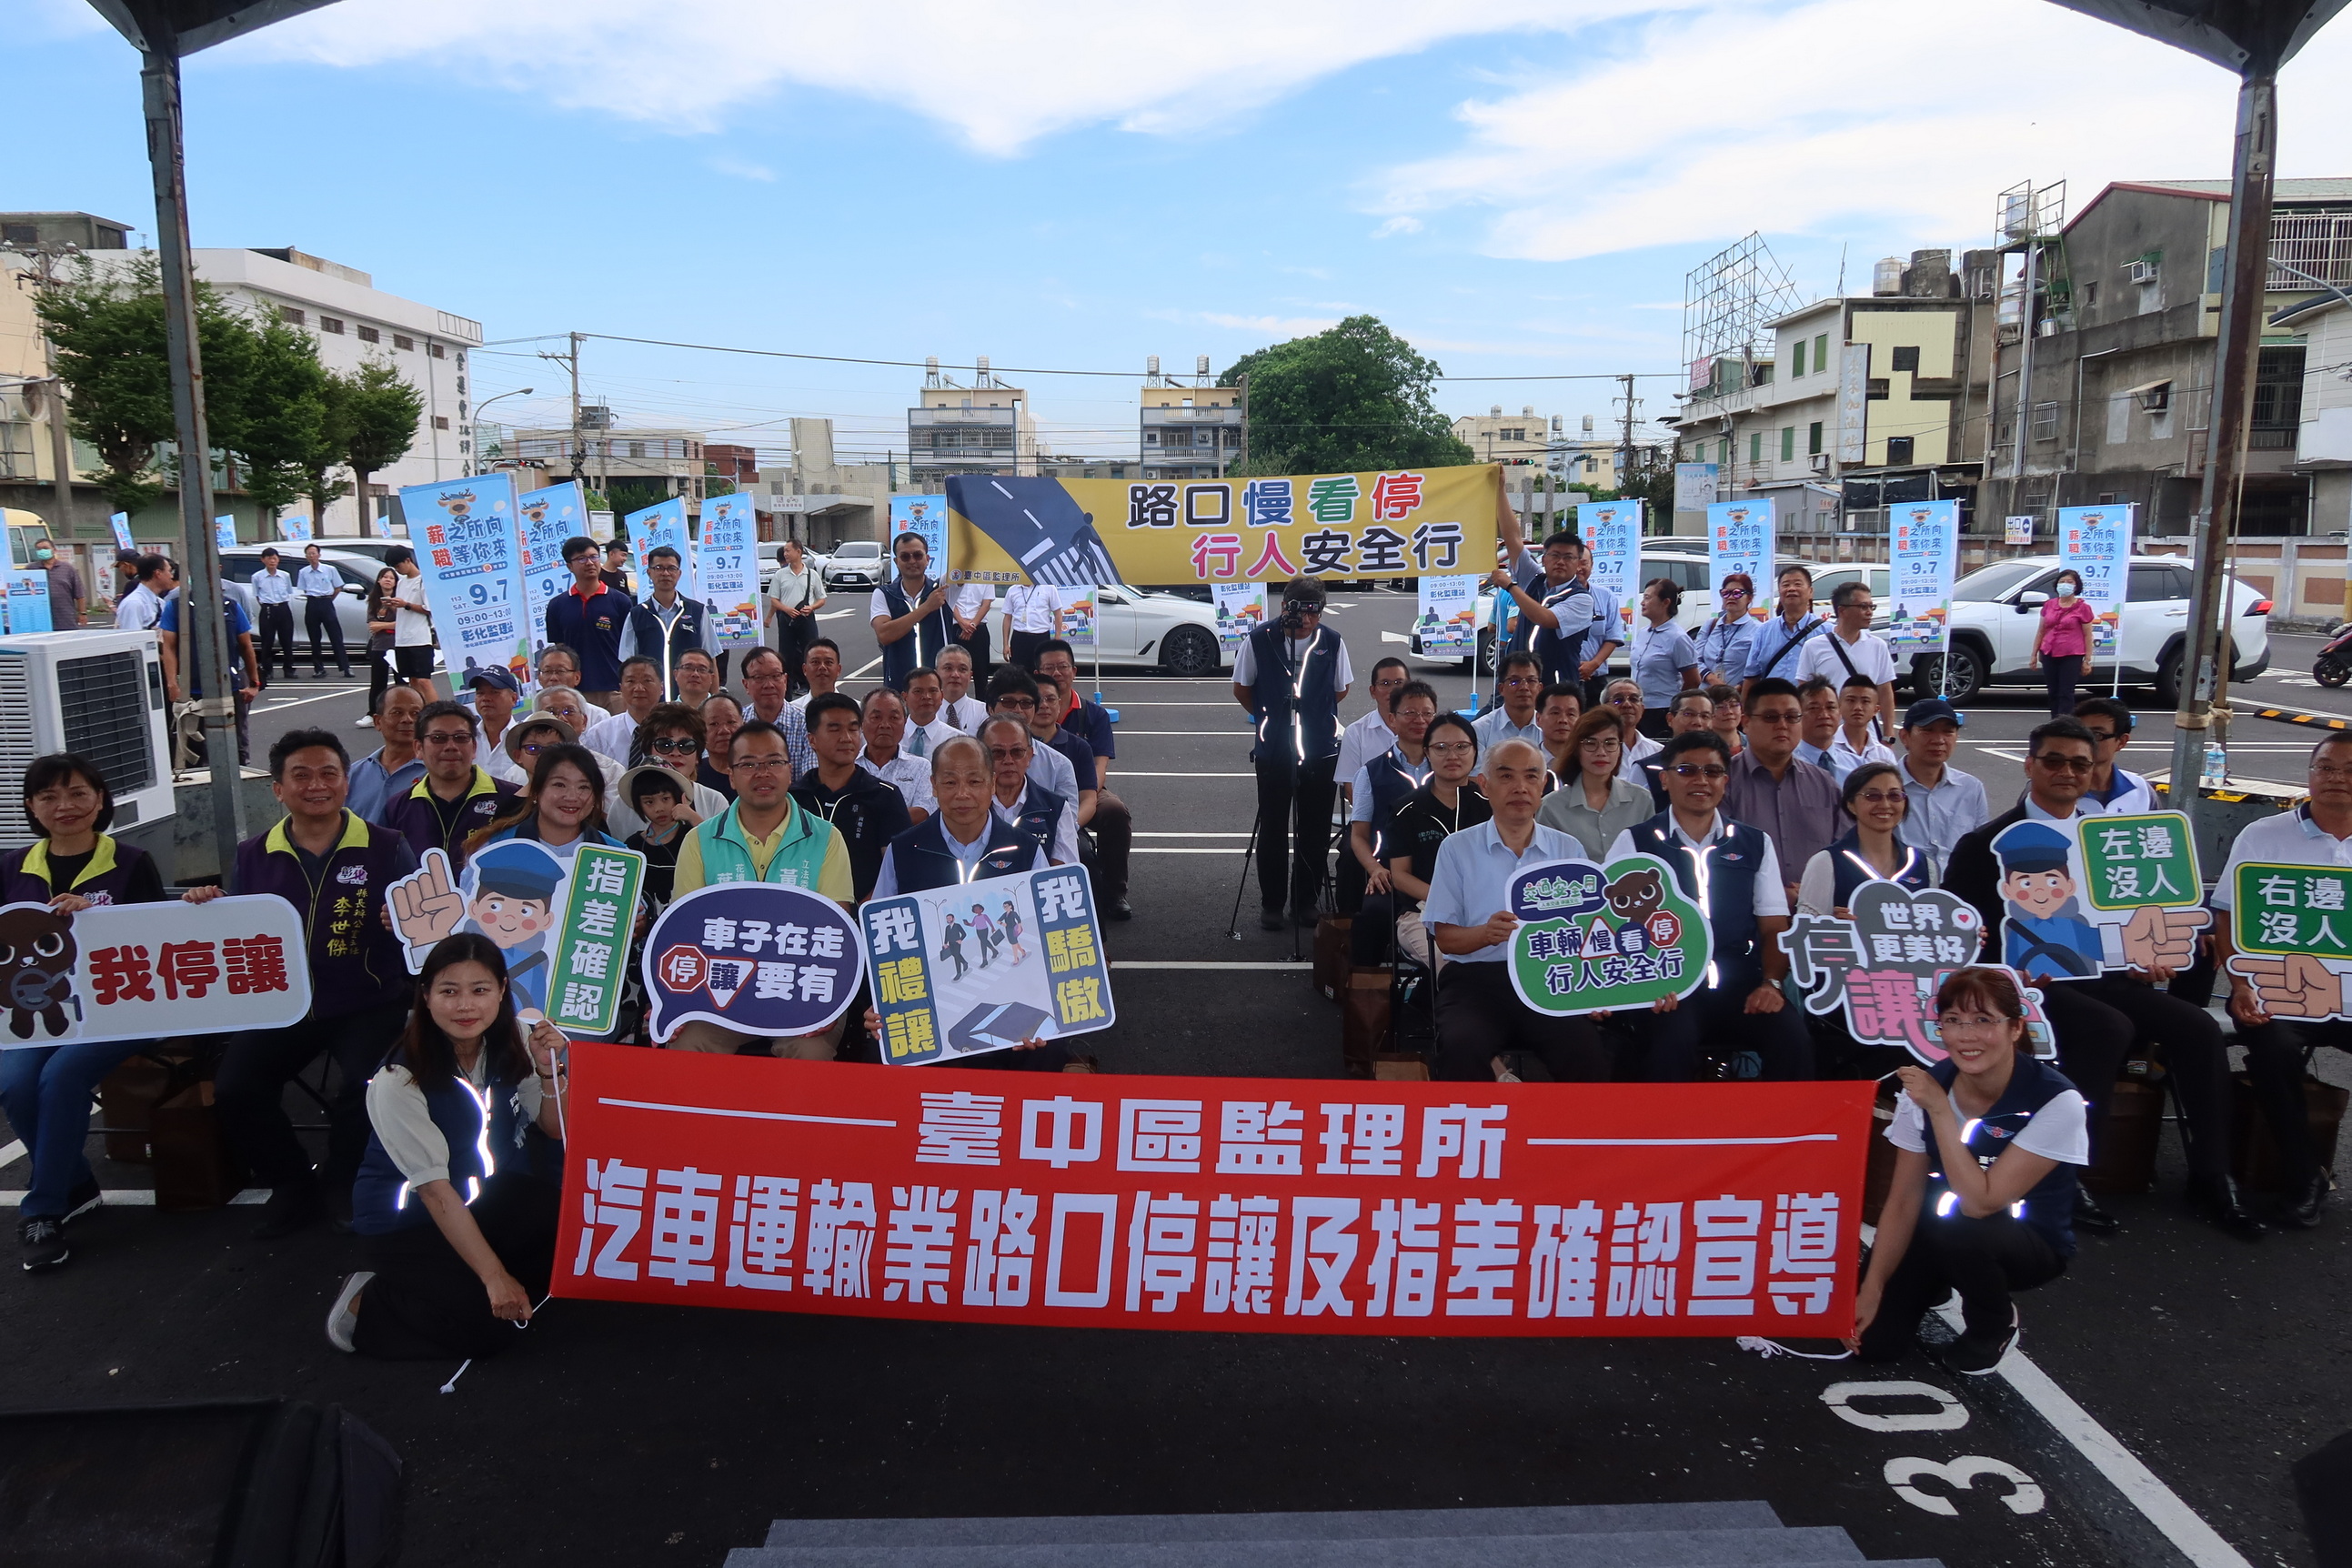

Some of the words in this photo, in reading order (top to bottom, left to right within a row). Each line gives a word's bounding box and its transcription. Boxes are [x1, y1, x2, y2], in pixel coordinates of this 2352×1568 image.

[1128, 471, 1425, 529] 路口慢看停
[427, 516, 504, 545] 薪之所向
[705, 518, 742, 532] 薪之所向
[899, 519, 939, 531] 薪之所向
[1586, 524, 1627, 538] 薪之所向
[1717, 524, 1762, 538] 薪之所向
[1898, 524, 1943, 538] 薪之所向
[2007, 518, 2021, 530] 出口
[2068, 528, 2116, 541] 薪之所向
[704, 531, 744, 546] 職等你來
[1717, 538, 1762, 551] 職等你來
[1898, 538, 1943, 550] 職等你來
[2068, 543, 2116, 554] 職等你來
[431, 538, 508, 568] 職等你來
[522, 540, 567, 568] 職等你
[1191, 521, 1464, 580] 行人安全行
[716, 556, 741, 569] 9.7
[1598, 561, 1623, 574] 9.7
[1912, 561, 1937, 574] 9.7
[2085, 565, 2111, 578] 9.7
[707, 572, 743, 580] 09:00-13:00
[708, 581, 744, 590] 彰化監理站
[963, 570, 1020, 582] 臺中區監理所
[1430, 580, 1466, 588] 09:00-13:00
[469, 578, 508, 606] 9.7
[1430, 588, 1466, 598] 彰化監理站
[457, 608, 512, 626] 09:00-13:00
[2099, 826, 2174, 862] 左邊
[2106, 864, 2182, 900] 沒人
[2258, 876, 2346, 910] 右邊
[327, 896, 353, 958] 李世傑
[1880, 902, 1944, 930] 世界
[559, 856, 627, 1022] 指差確認
[702, 916, 846, 959] 車子在走
[2259, 911, 2351, 949] 沒人
[1037, 874, 1107, 1027] 我驕傲
[1870, 933, 1966, 964] 更美好
[89, 933, 289, 1006] 我停讓
[1546, 948, 1684, 994] 行人安全行
[869, 904, 937, 1060] 我禮讓
[916, 1091, 1508, 1180] 臺中區監理所
[573, 1158, 1840, 1319] 汽車運輸業路口停讓及指差確認宣導
